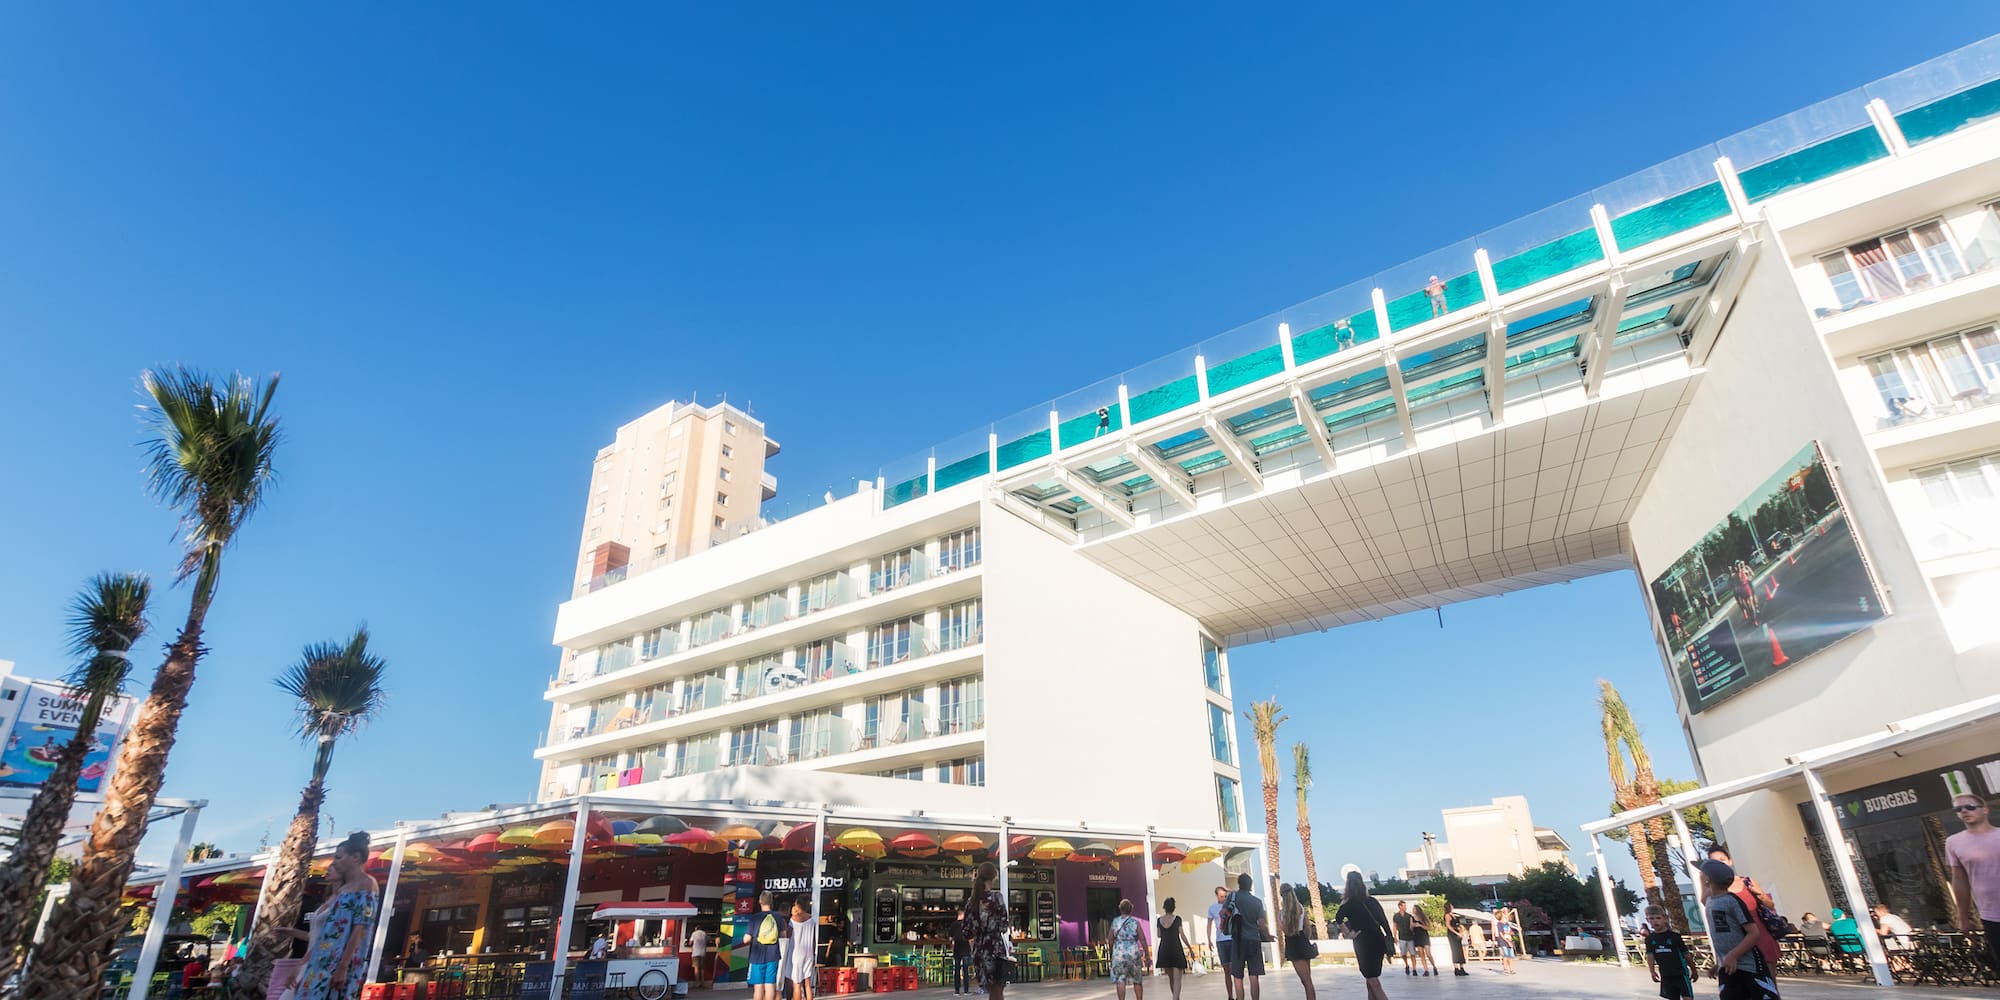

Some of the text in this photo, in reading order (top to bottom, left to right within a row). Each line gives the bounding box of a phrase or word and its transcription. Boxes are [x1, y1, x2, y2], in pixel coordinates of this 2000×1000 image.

[39, 709, 104, 727] EVENS
[1863, 789, 1918, 813] BURGERS
[764, 876, 844, 890] URBAN OOD
